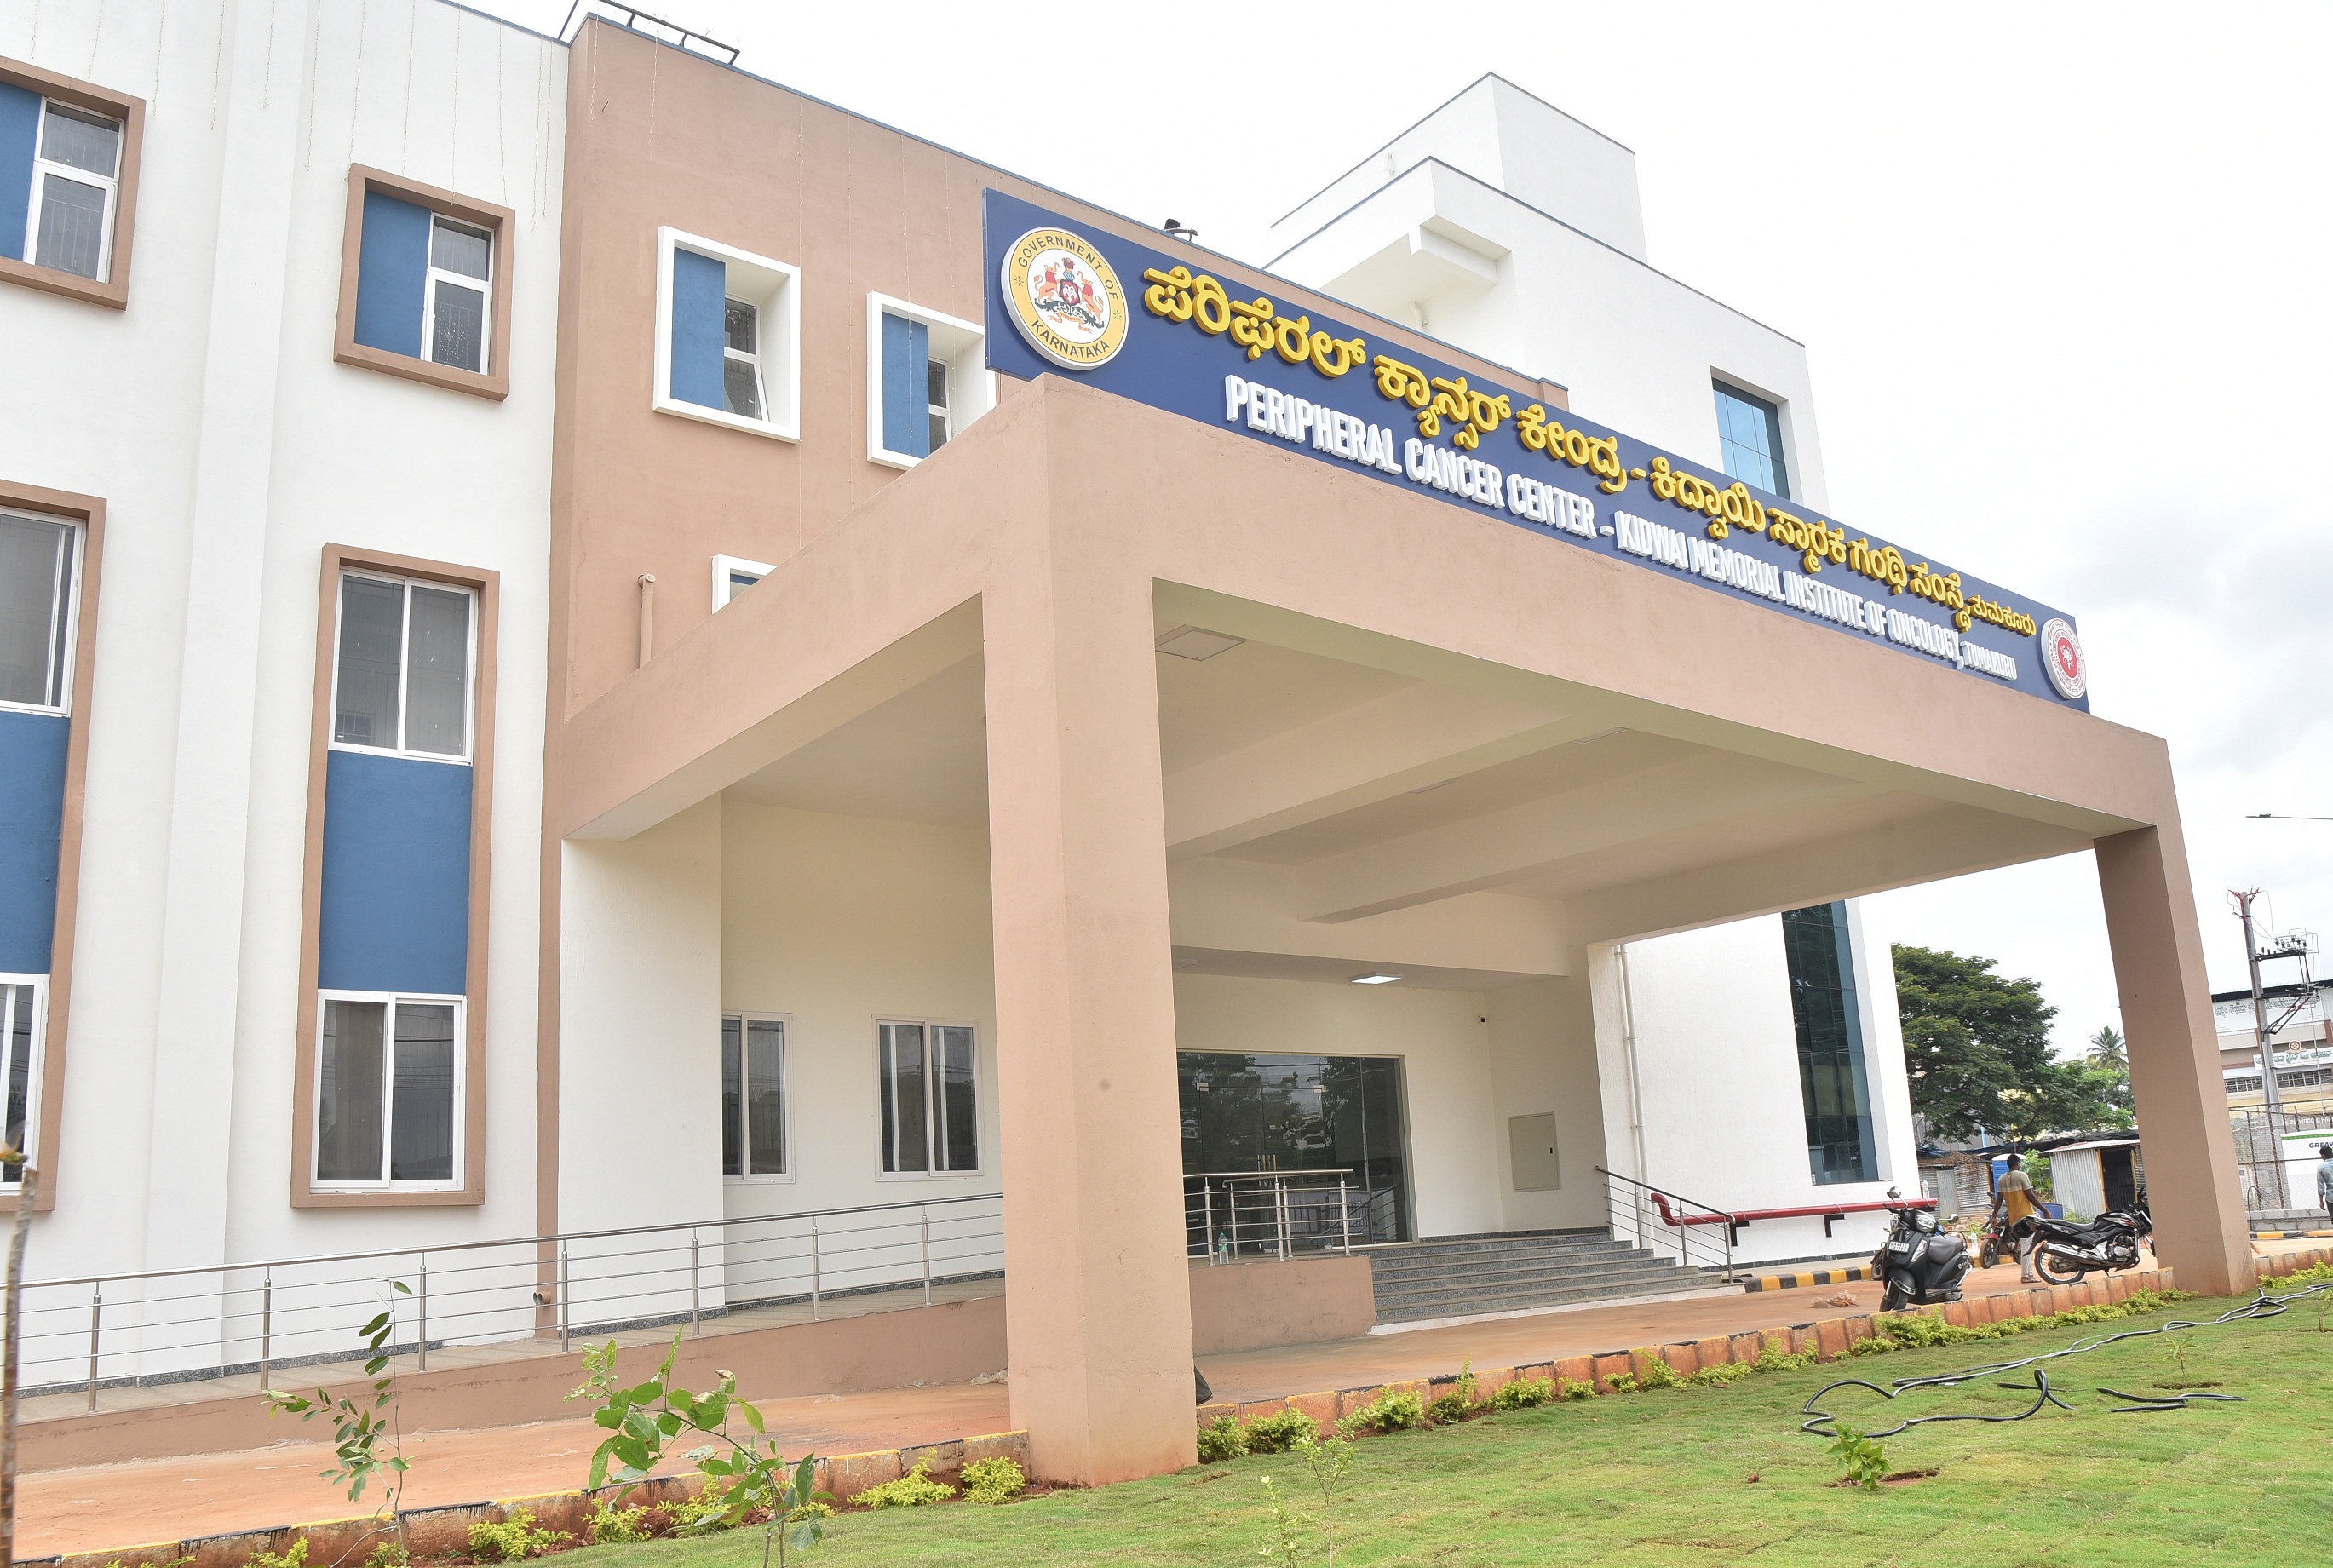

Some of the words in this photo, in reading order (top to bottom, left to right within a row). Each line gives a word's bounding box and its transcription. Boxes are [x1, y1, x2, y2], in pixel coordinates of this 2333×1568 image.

[1018, 235, 1104, 270] GOVERNMENT
[1104, 279, 1118, 301] OF
[1031, 319, 1111, 359] KARNATAKA
[1144, 265, 1366, 378] ಪೆರಿಫೆರಲ್
[1373, 354, 1512, 451] ಕ್ಯಾನ್ಸರ್
[1516, 403, 1628, 494] ಕೇಂದ್ರ
[1630, 468, 1646, 480] -
[1650, 456, 1766, 540] ಕಿದ್ವಾಯಿ
[1767, 508, 1847, 574] ಸ್ಮಾರಕ
[1907, 562, 1971, 632] ಸಂಸ್ಥೆ
[1967, 594, 2037, 636] ತುಮಕೂರು
[1224, 374, 1403, 475] PERIPHERAL
[1404, 437, 1505, 509] CANCER
[1506, 473, 1597, 539] CENTER
[1600, 524, 1615, 537] -
[1614, 510, 1689, 570] KIDWAI
[1687, 536, 1785, 603] MEMORIAL
[1784, 571, 1867, 629] INSTITUTE
[1864, 600, 1887, 635] OF
[1886, 608, 1964, 669] ONCOLOGY,
[1961, 641, 2018, 681] TUMAKURU
